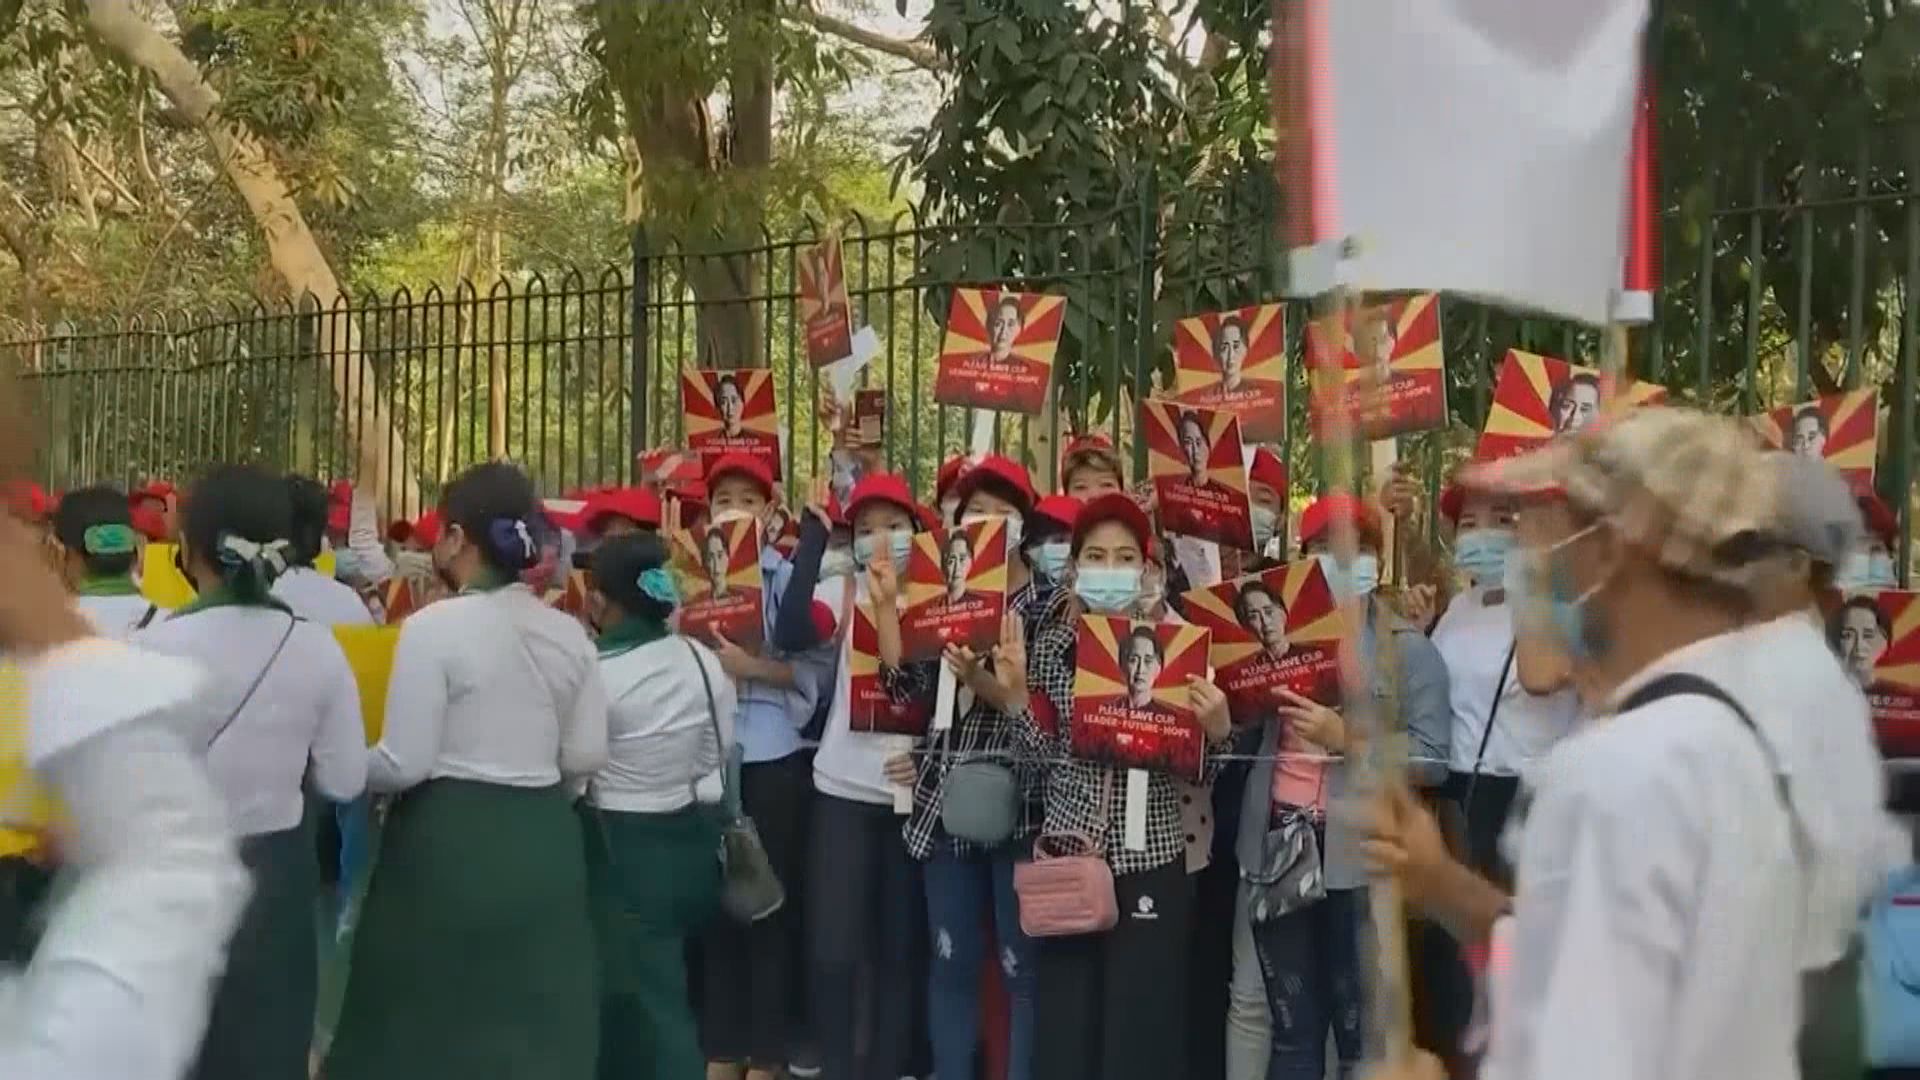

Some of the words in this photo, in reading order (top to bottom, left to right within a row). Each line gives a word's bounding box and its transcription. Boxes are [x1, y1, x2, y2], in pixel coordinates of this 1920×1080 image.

[1273, 655, 1300, 670] SAVE
[1301, 650, 1324, 663] OUR
[1099, 703, 1128, 719] PLEASE
[1129, 709, 1154, 722] SAVE
[1155, 713, 1176, 726] OUR
